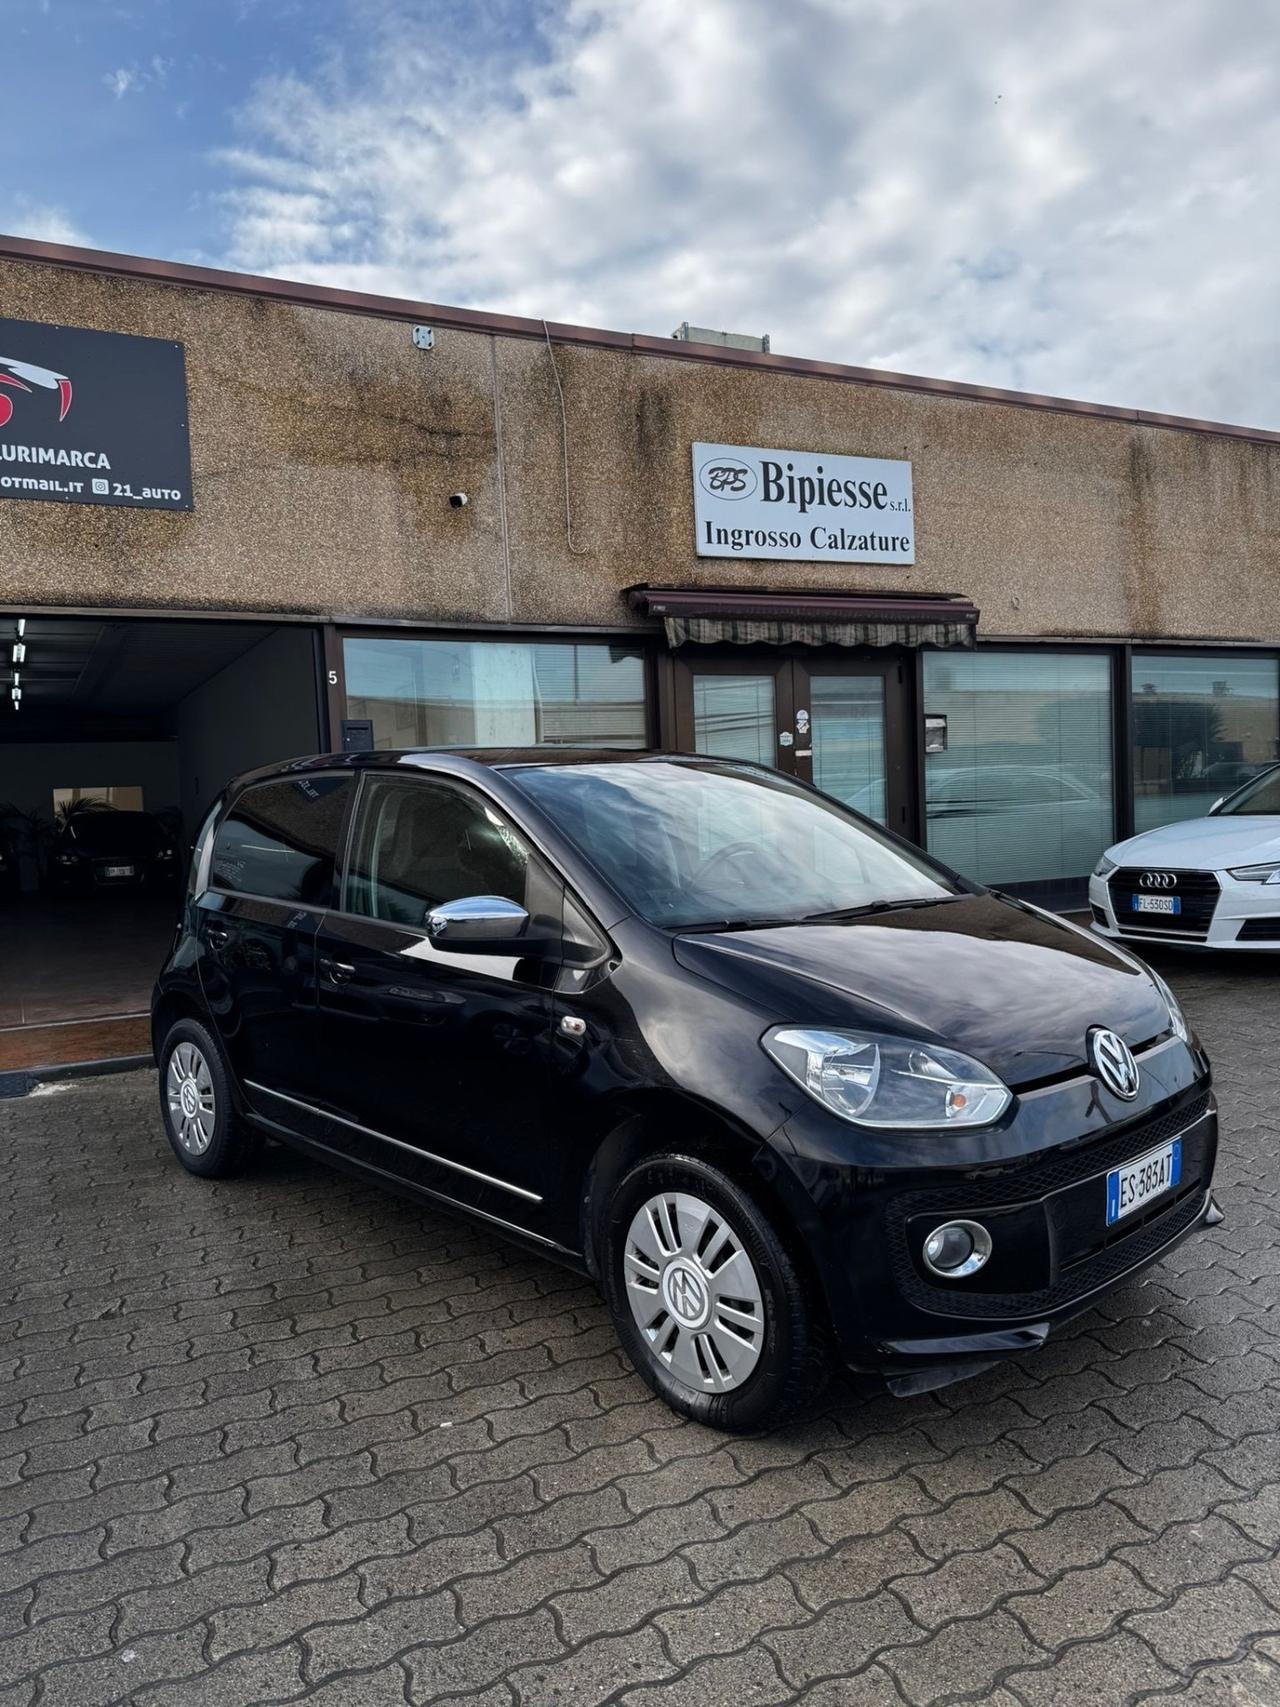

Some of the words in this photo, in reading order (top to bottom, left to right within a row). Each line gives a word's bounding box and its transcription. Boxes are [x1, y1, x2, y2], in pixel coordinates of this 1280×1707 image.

[0, 444, 111, 470] URIMARCA
[708, 466, 748, 492] BPS
[759, 460, 887, 513] Bipiesse
[889, 498, 911, 512] s.r.l.
[704, 520, 801, 550] Ingrosso
[810, 526, 910, 552] Calzature
[328, 670, 338, 684] 5
